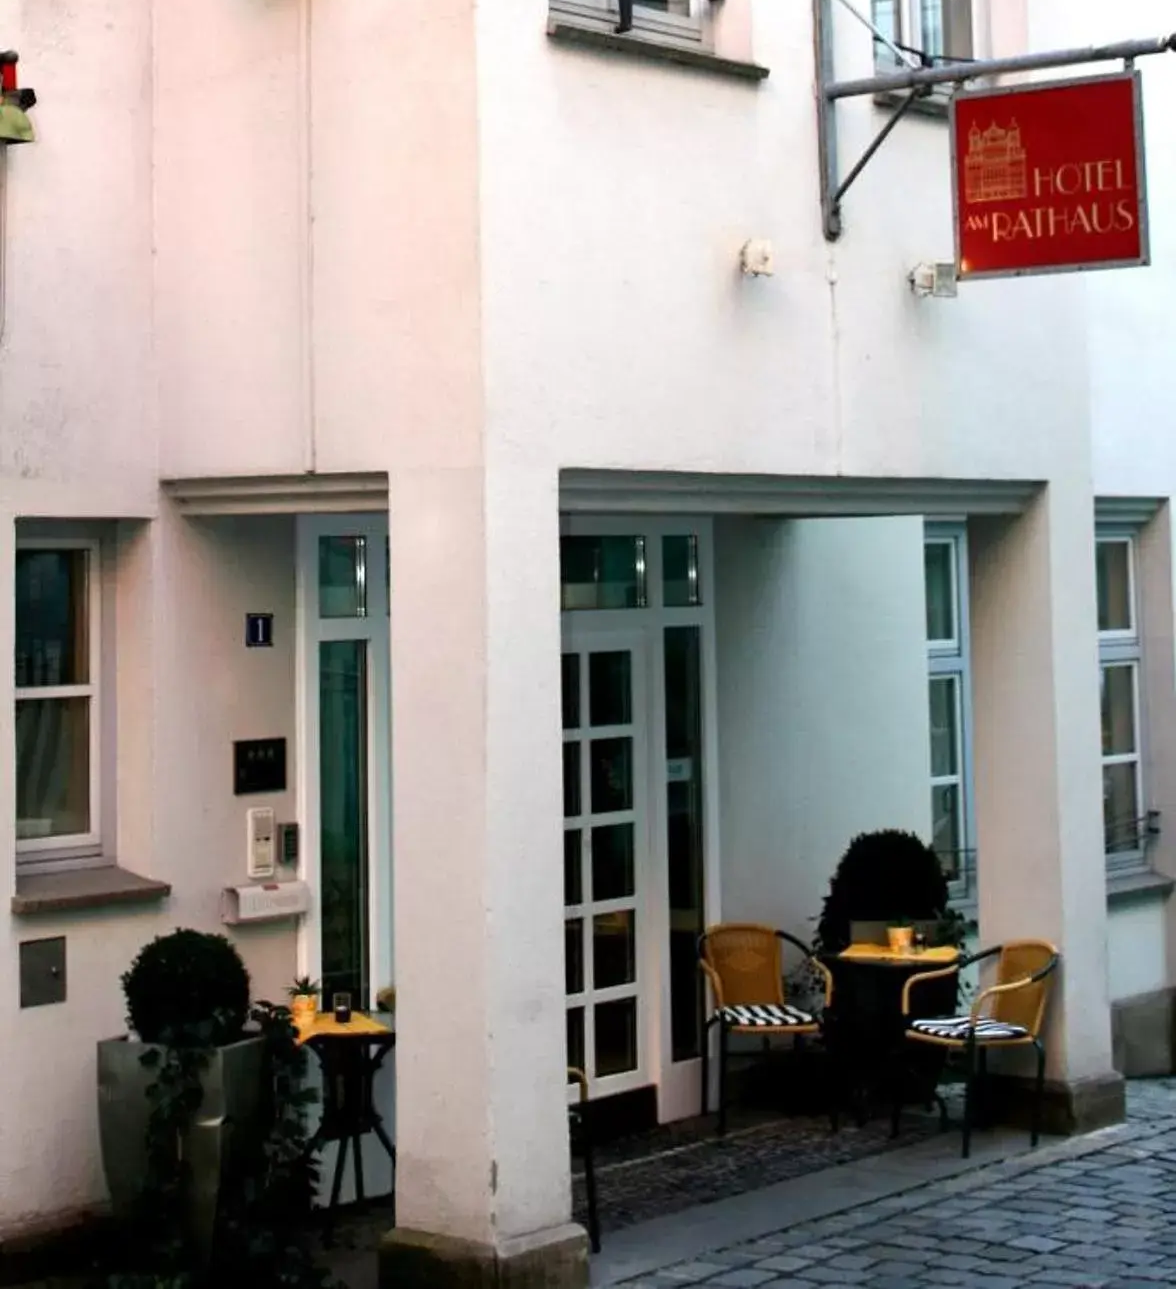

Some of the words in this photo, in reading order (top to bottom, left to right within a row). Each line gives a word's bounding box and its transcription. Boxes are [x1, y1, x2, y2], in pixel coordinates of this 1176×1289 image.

[1033, 159, 1133, 197] HOTEL
[964, 214, 988, 231] AM
[991, 199, 1134, 242] RATHAUS
